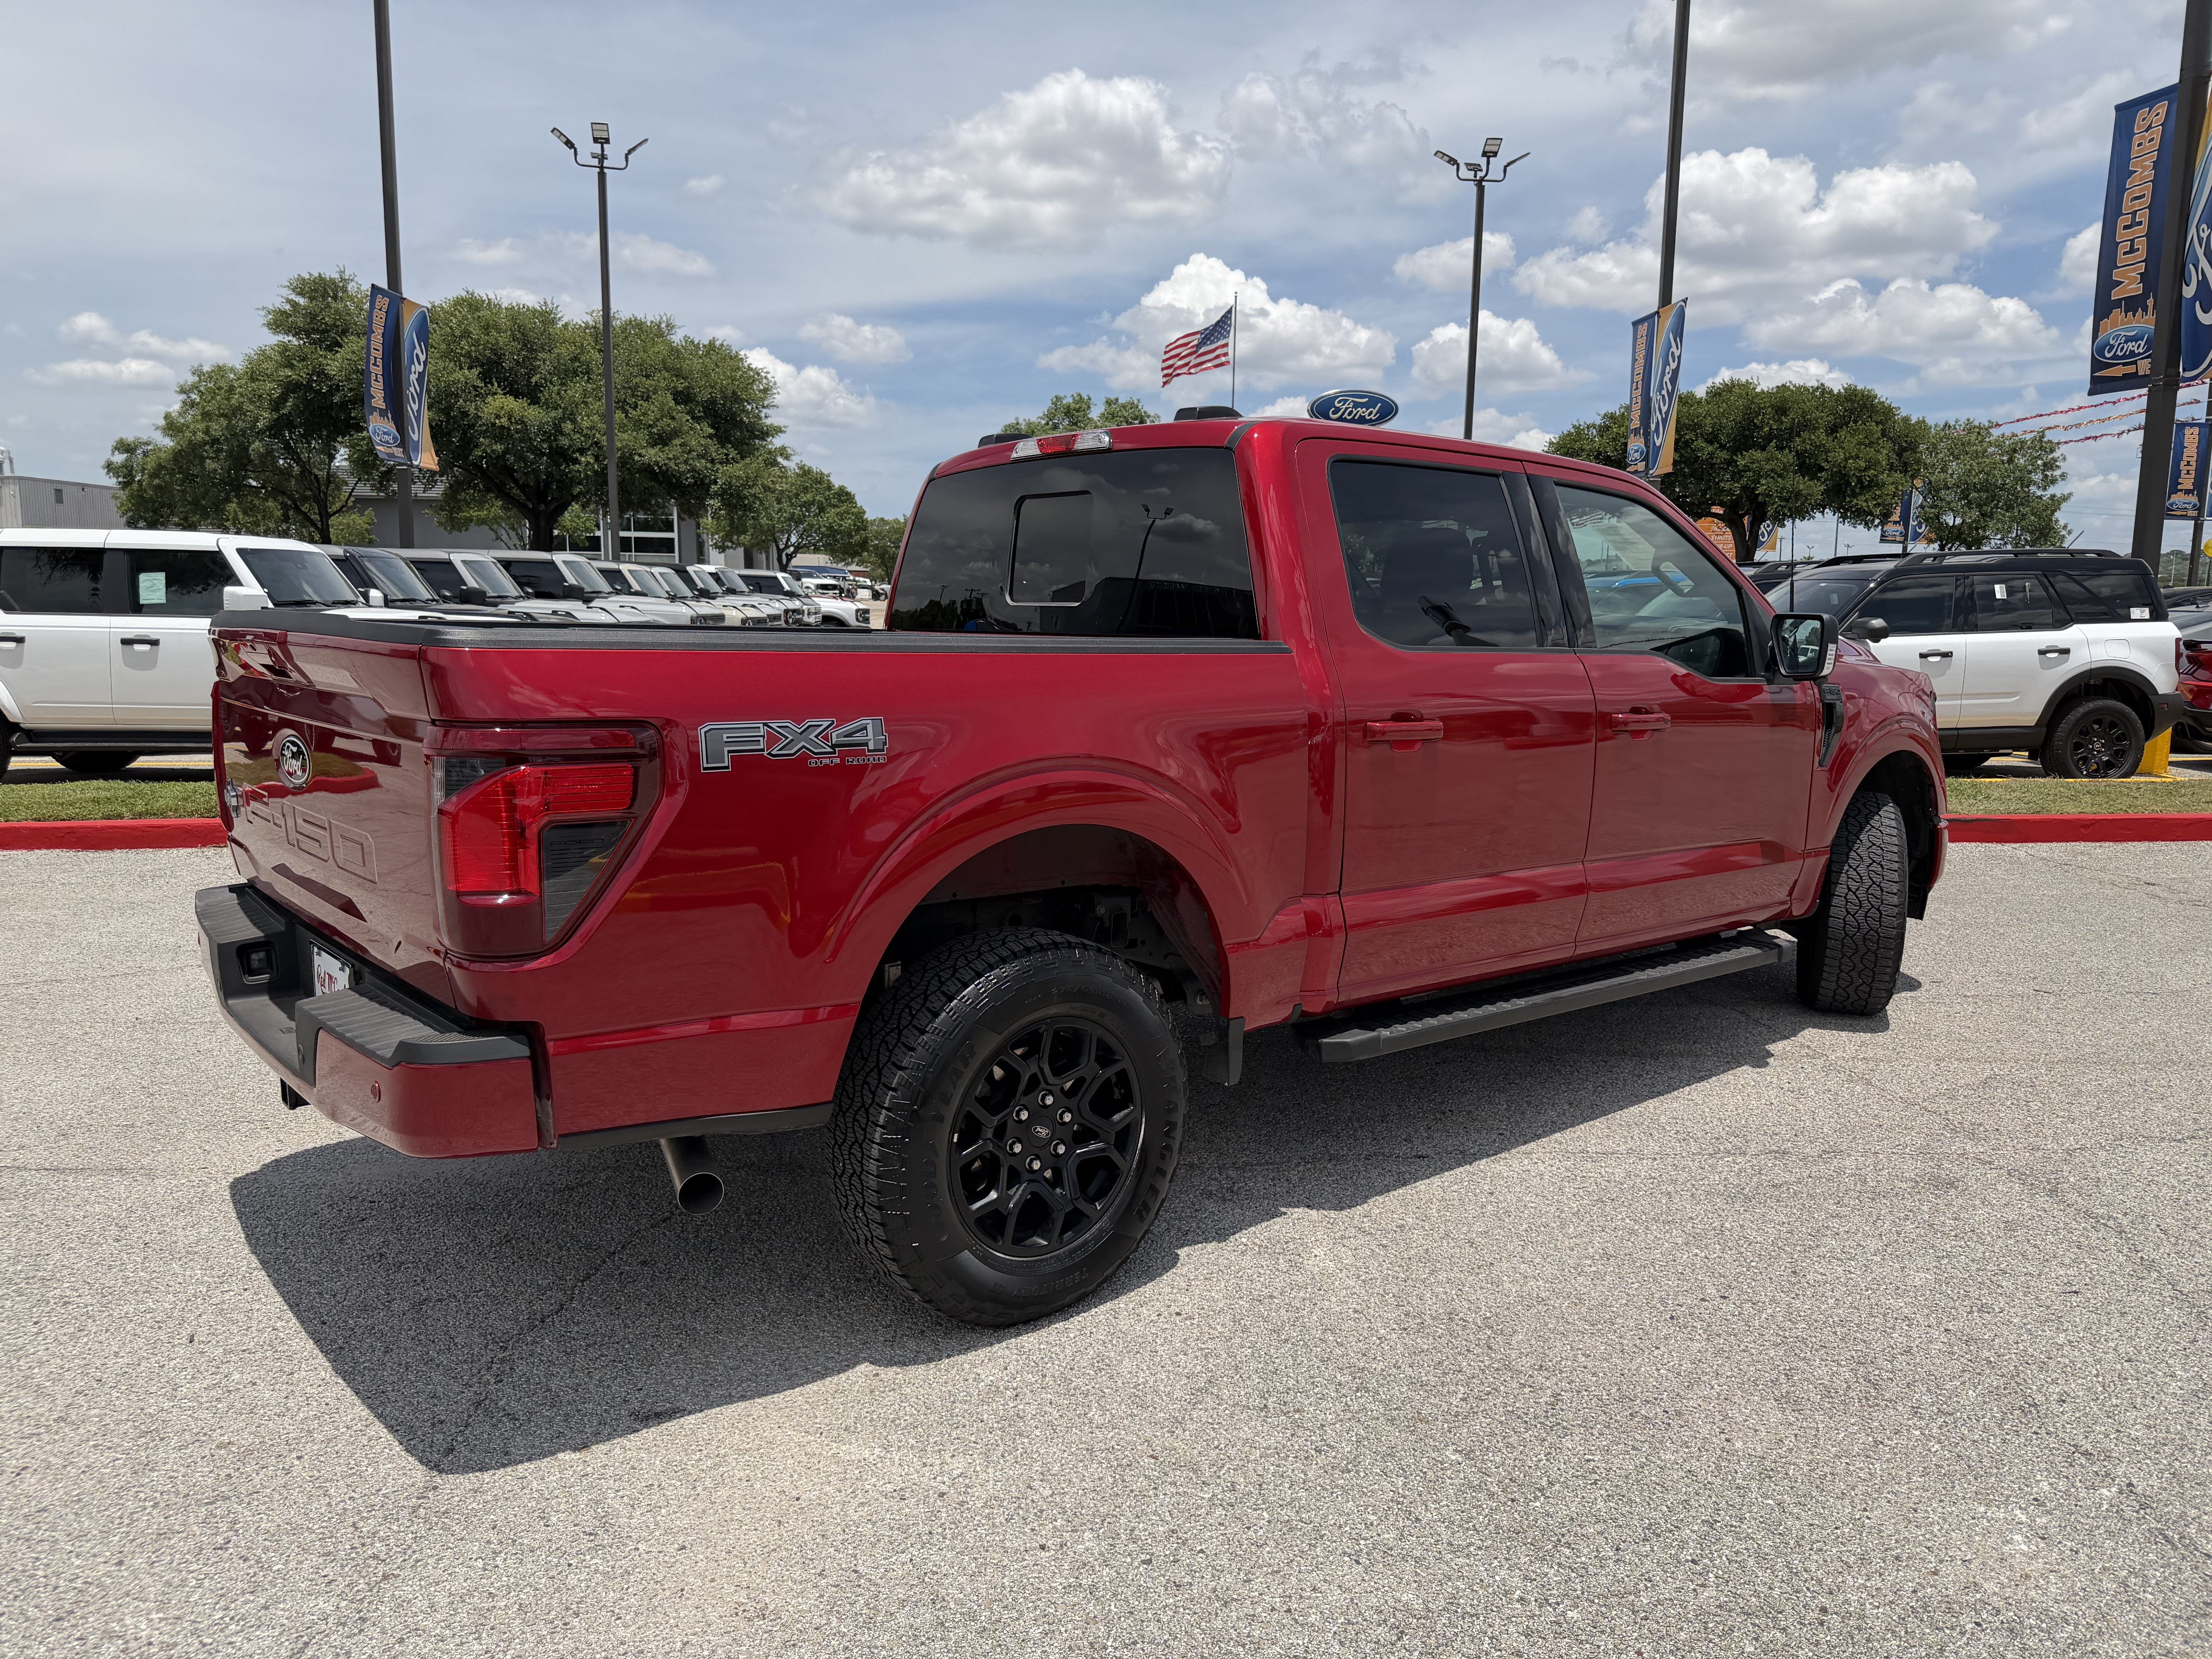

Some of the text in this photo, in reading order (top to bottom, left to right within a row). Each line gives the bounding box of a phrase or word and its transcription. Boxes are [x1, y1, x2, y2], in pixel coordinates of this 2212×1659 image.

[2105, 330, 2148, 358] Ford
[2137, 359, 2151, 376] WE
[1650, 331, 1681, 446] Ford
[1328, 397, 1381, 420] Ford
[376, 427, 395, 443] Ford
[1628, 446, 1641, 461] Ford
[2173, 501, 2193, 509] Ford
[698, 717, 888, 772] FX4
[283, 742, 303, 776] Ford
[808, 756, 887, 767] OFF ROAD
[243, 782, 378, 884] F-150
[550, 838, 605, 847] FORD
[1035, 1127, 1048, 1137] Ford
